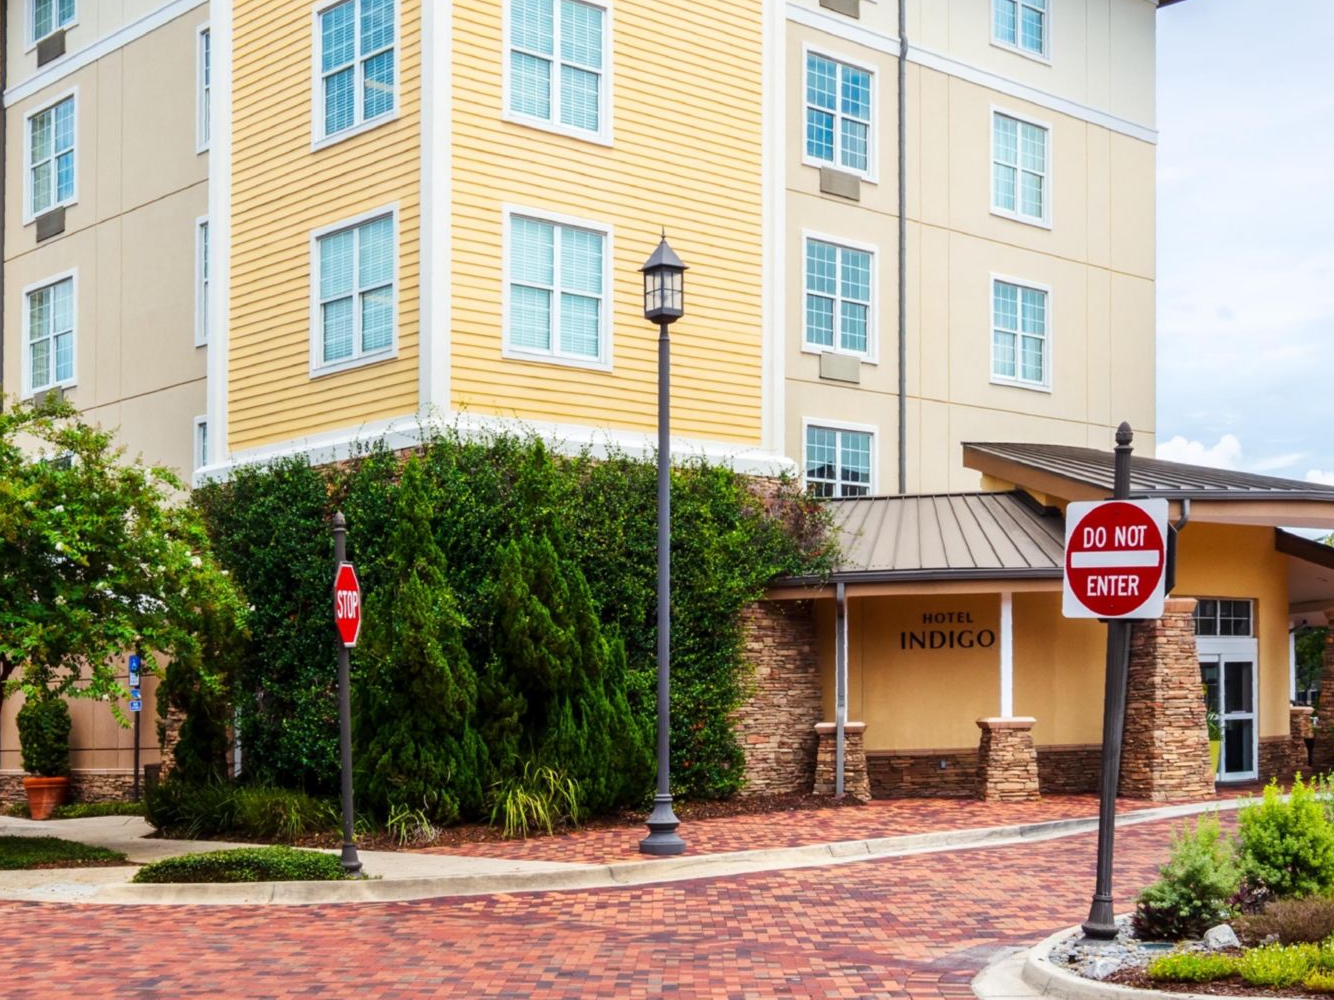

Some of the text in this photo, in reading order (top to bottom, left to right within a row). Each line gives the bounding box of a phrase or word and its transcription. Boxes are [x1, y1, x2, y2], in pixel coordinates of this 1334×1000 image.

[1083, 525, 1148, 548] DO NOT
[1087, 575, 1140, 596] ENTER
[337, 589, 358, 619] STOP
[922, 611, 974, 624] HOTEL
[900, 629, 996, 650] INDIGO
